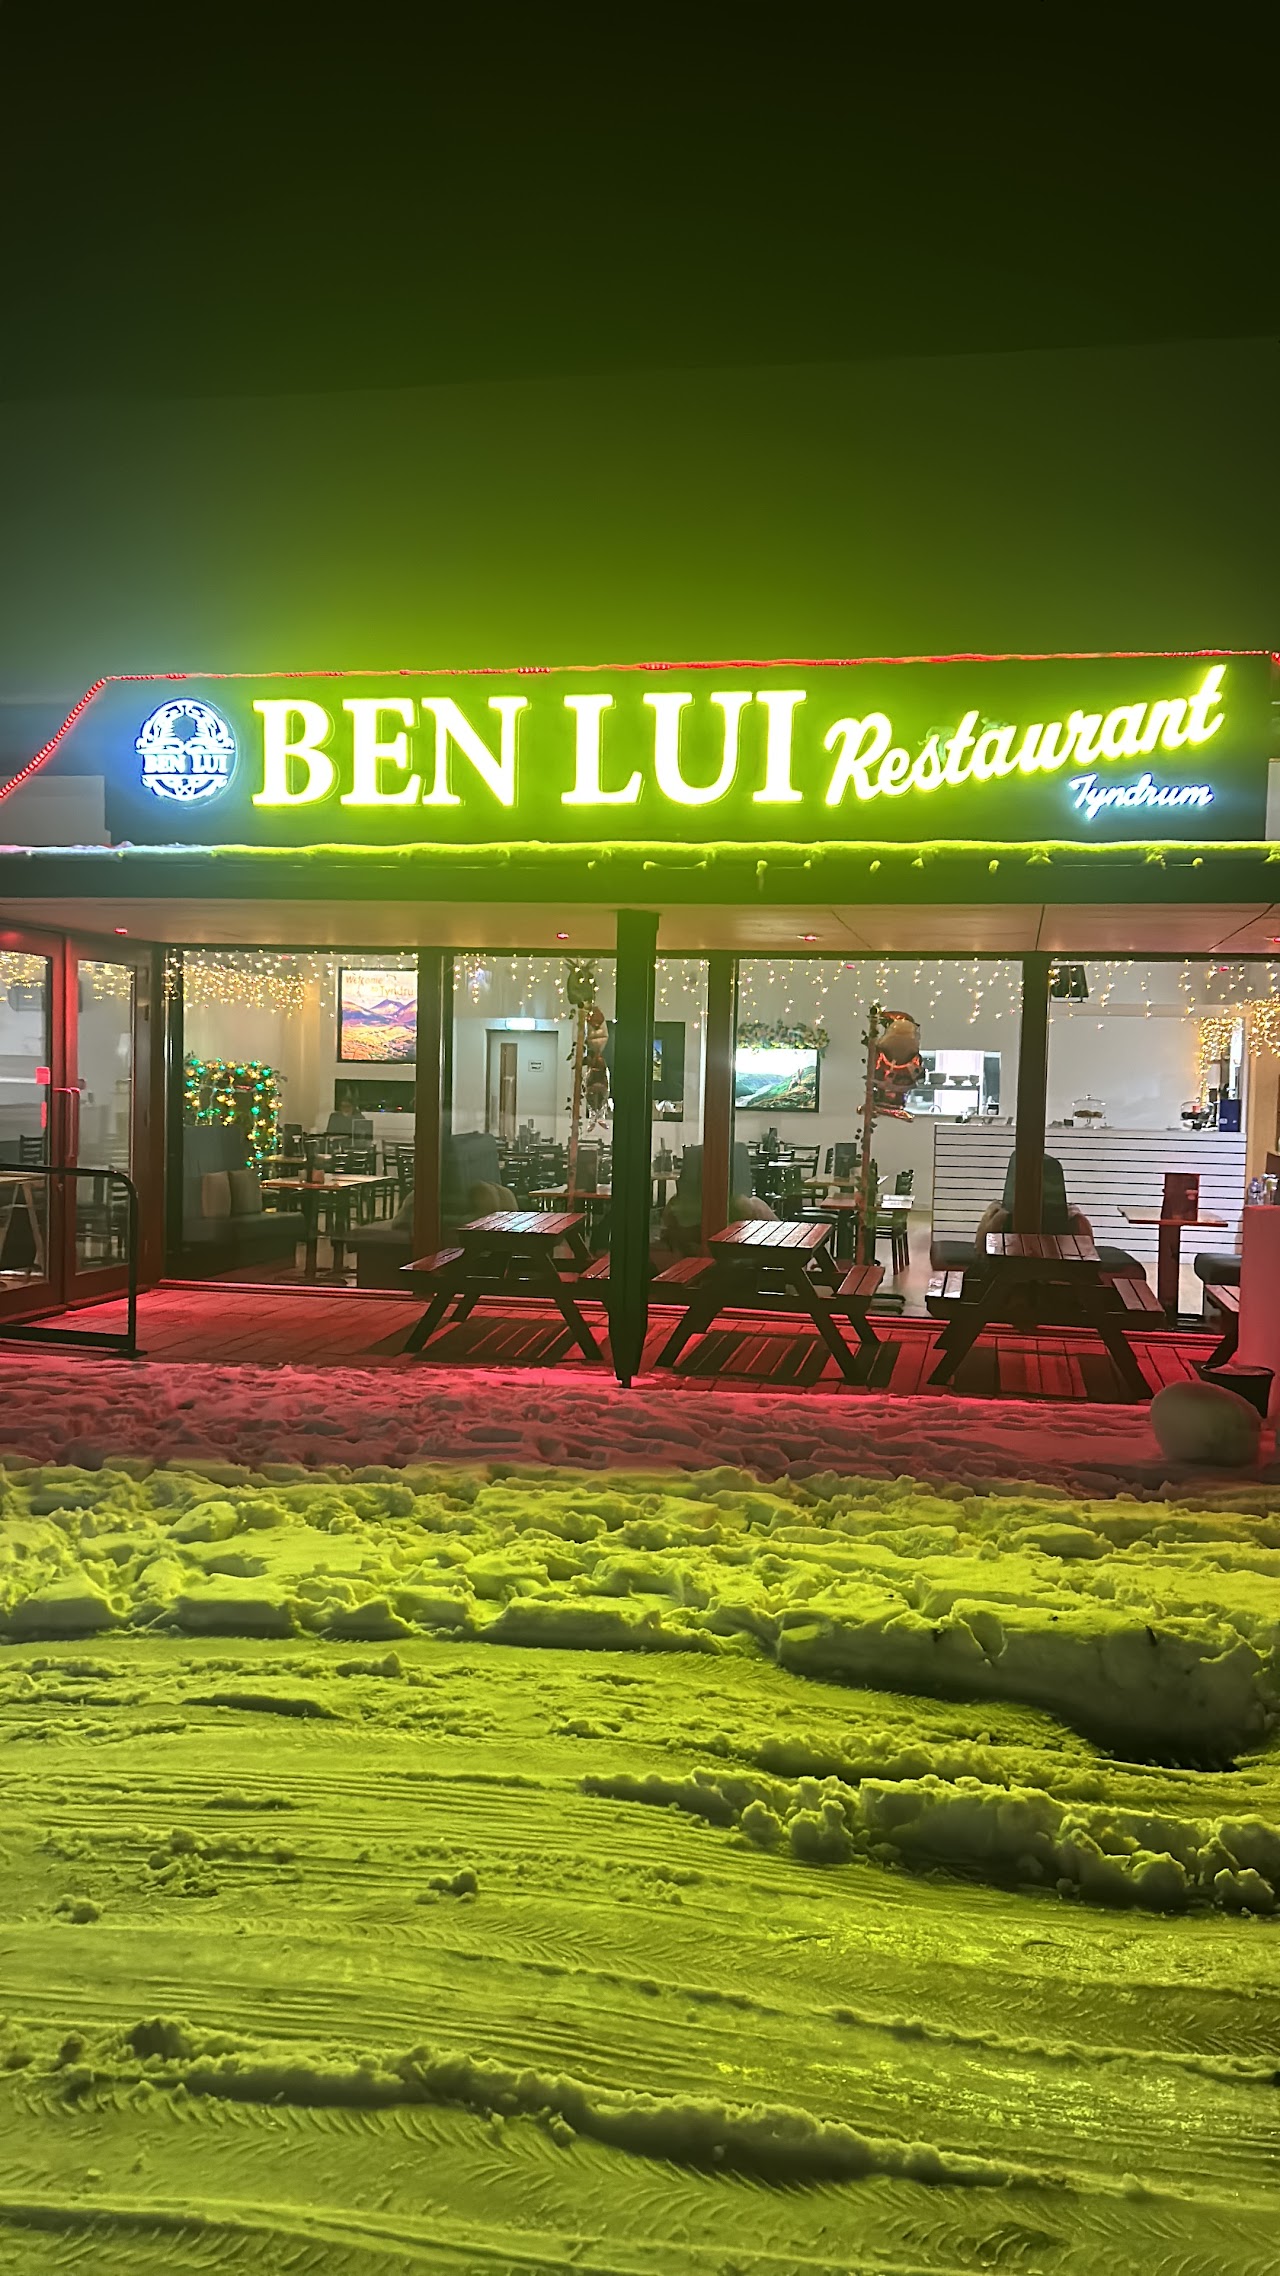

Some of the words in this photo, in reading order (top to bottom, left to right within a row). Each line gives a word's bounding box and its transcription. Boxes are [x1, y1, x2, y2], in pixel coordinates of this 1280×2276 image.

[251, 694, 532, 807] BEN
[560, 690, 807, 806] LUI
[823, 664, 1227, 807] Restaurant
[143, 754, 187, 773] BEN
[191, 754, 228, 773] LUI
[1068, 773, 1214, 820] Tyndrum
[345, 975, 383, 985] Welcome
[379, 985, 414, 997] Tyndru
